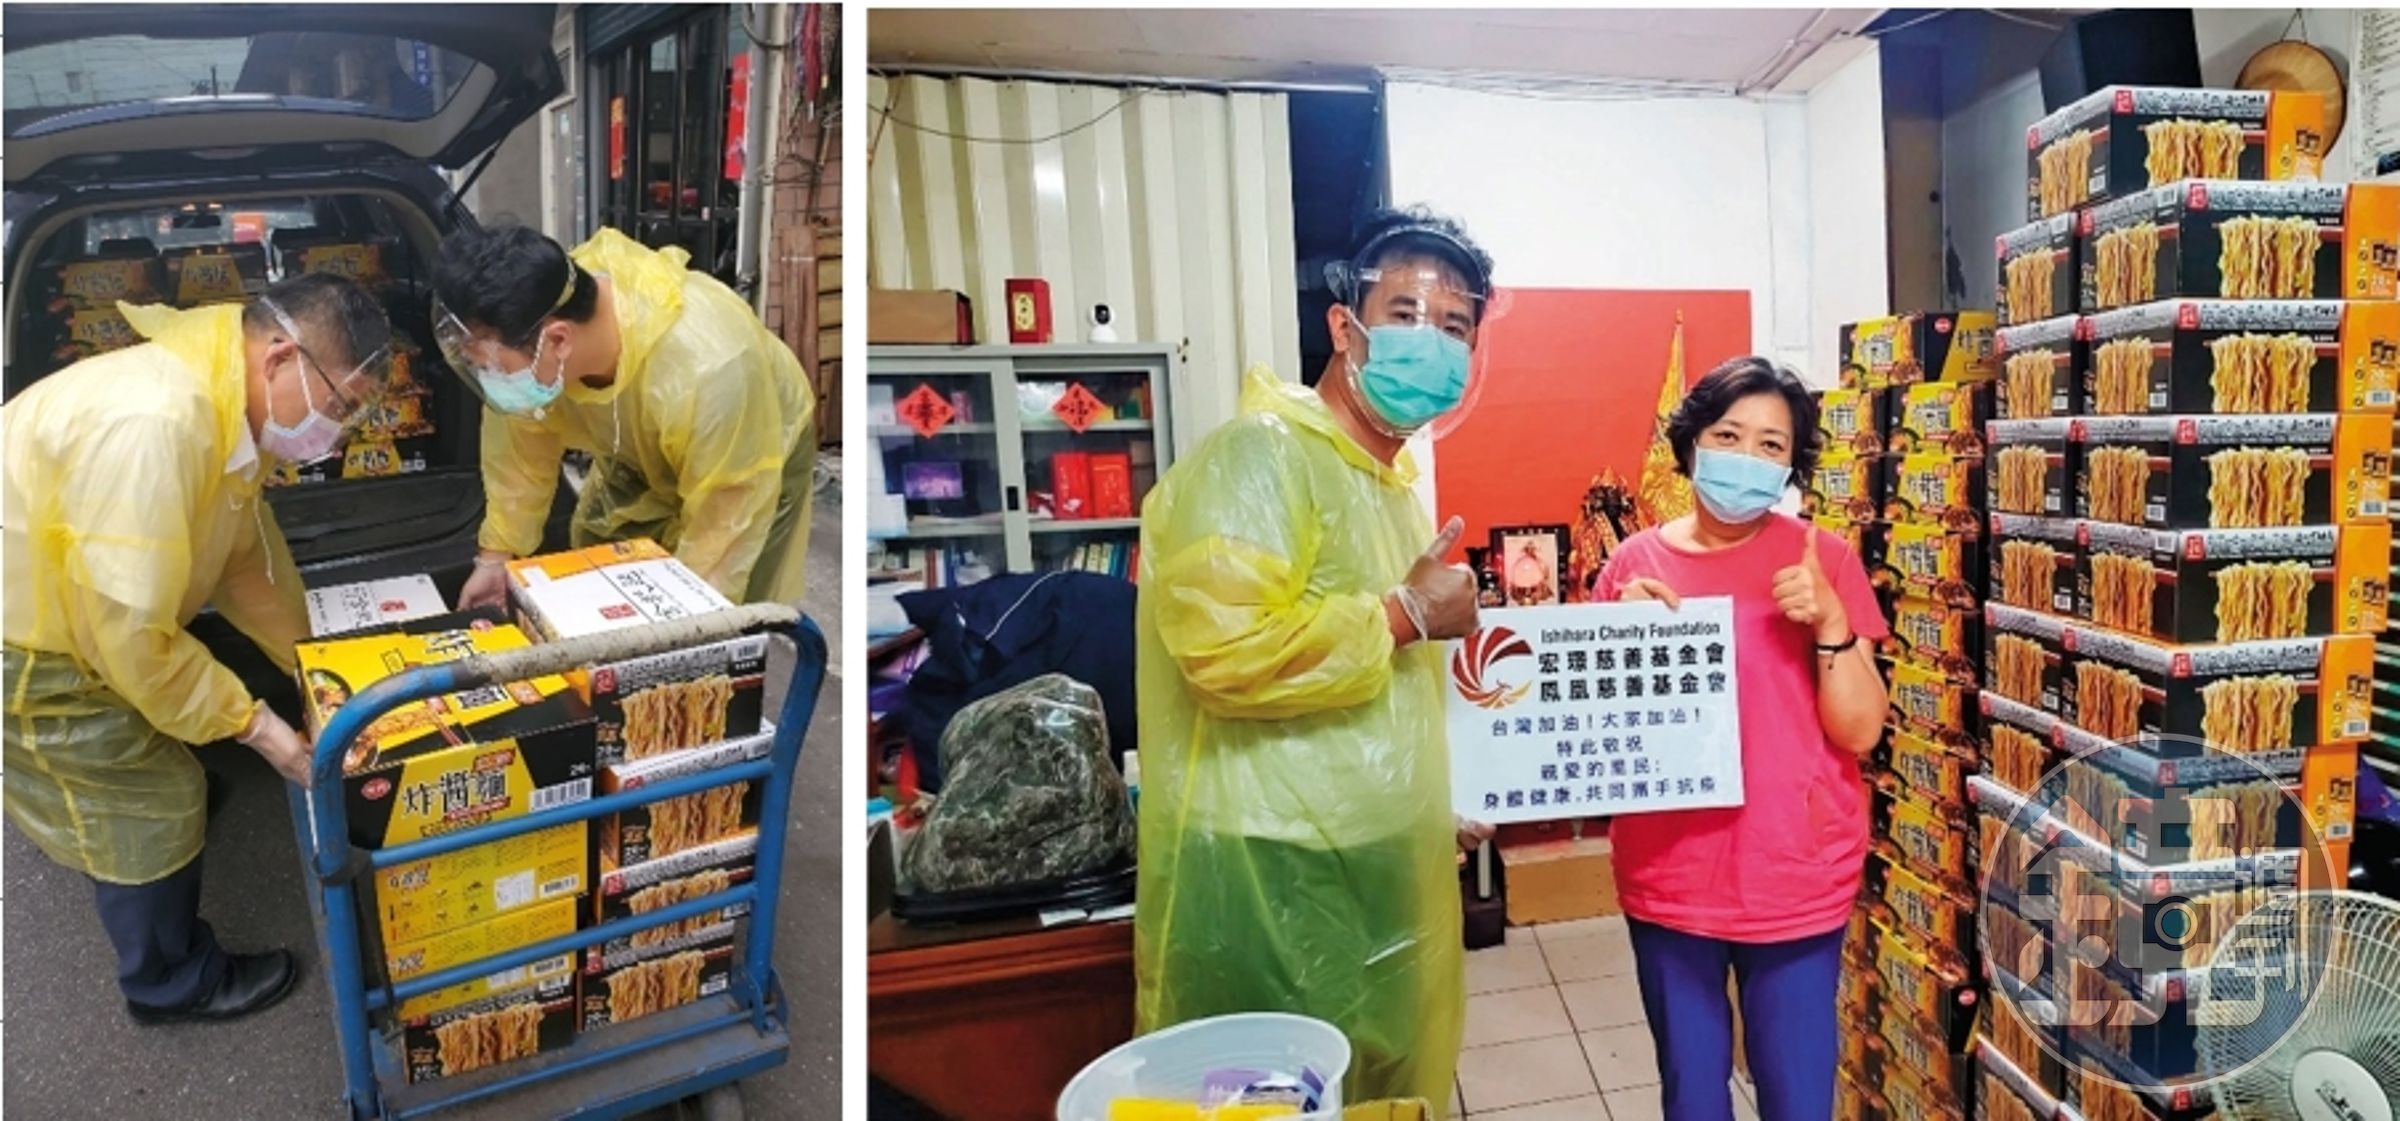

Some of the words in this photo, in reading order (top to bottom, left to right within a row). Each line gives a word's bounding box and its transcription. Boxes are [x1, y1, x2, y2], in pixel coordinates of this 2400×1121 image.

[1541, 628, 1595, 644] Ishihara
[1599, 624, 1646, 643] Charity
[1649, 621, 1721, 640] Foundation
[1539, 671, 1727, 703] 鳳凰慈善基金會
[1556, 735, 1645, 757] 特此敬祝
